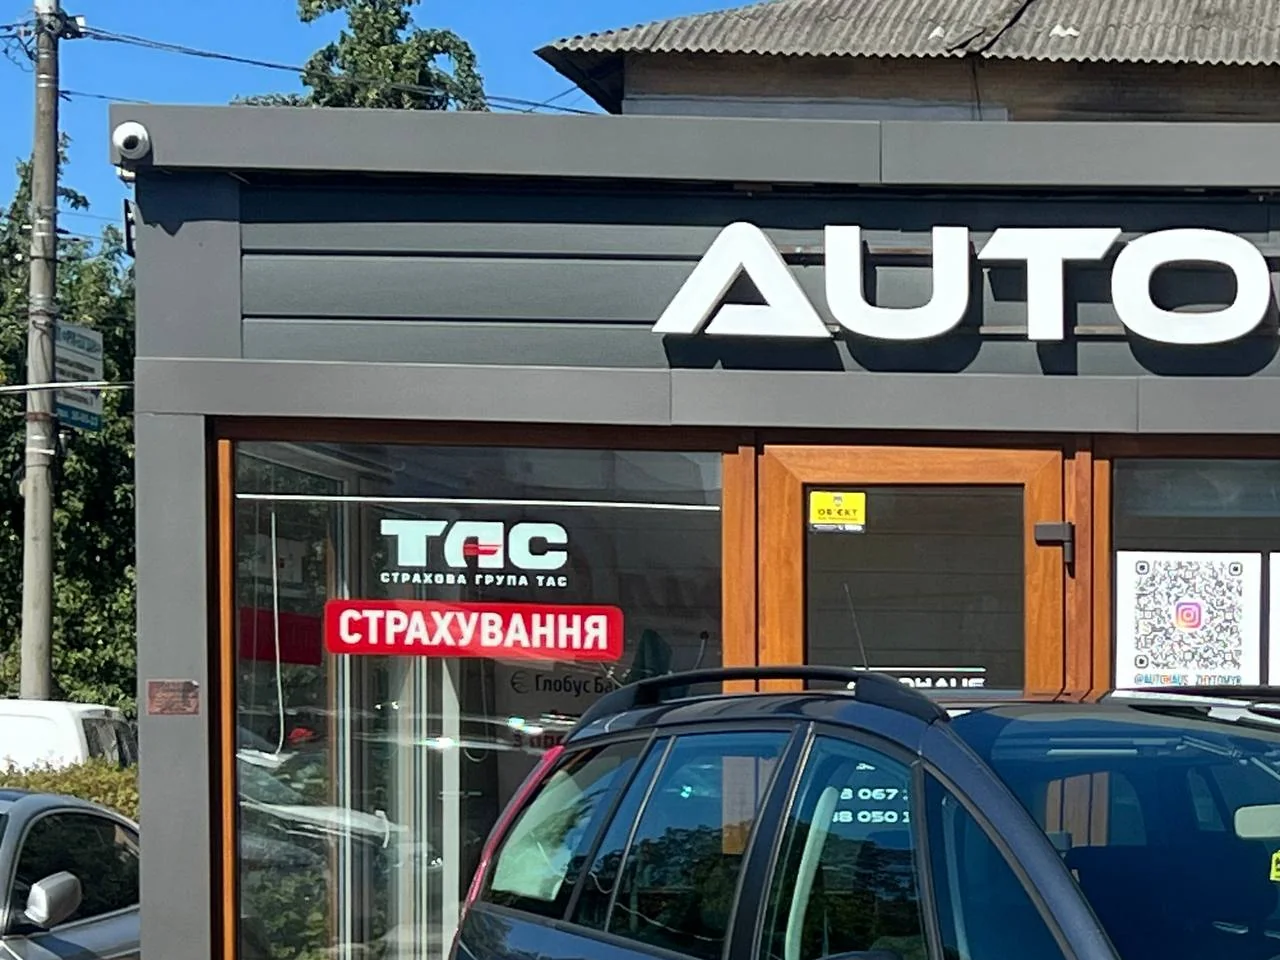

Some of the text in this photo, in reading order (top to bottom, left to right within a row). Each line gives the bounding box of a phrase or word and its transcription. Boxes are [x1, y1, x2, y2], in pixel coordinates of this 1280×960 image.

[380, 519, 568, 570] ТАС
[380, 572, 568, 587] СТРАХОВА ГРУПА ТАС
[338, 609, 609, 651] СТРАХУВАННЯ
[535, 674, 591, 698] Глобус
[858, 788, 900, 800] 067
[857, 811, 899, 823] 050
